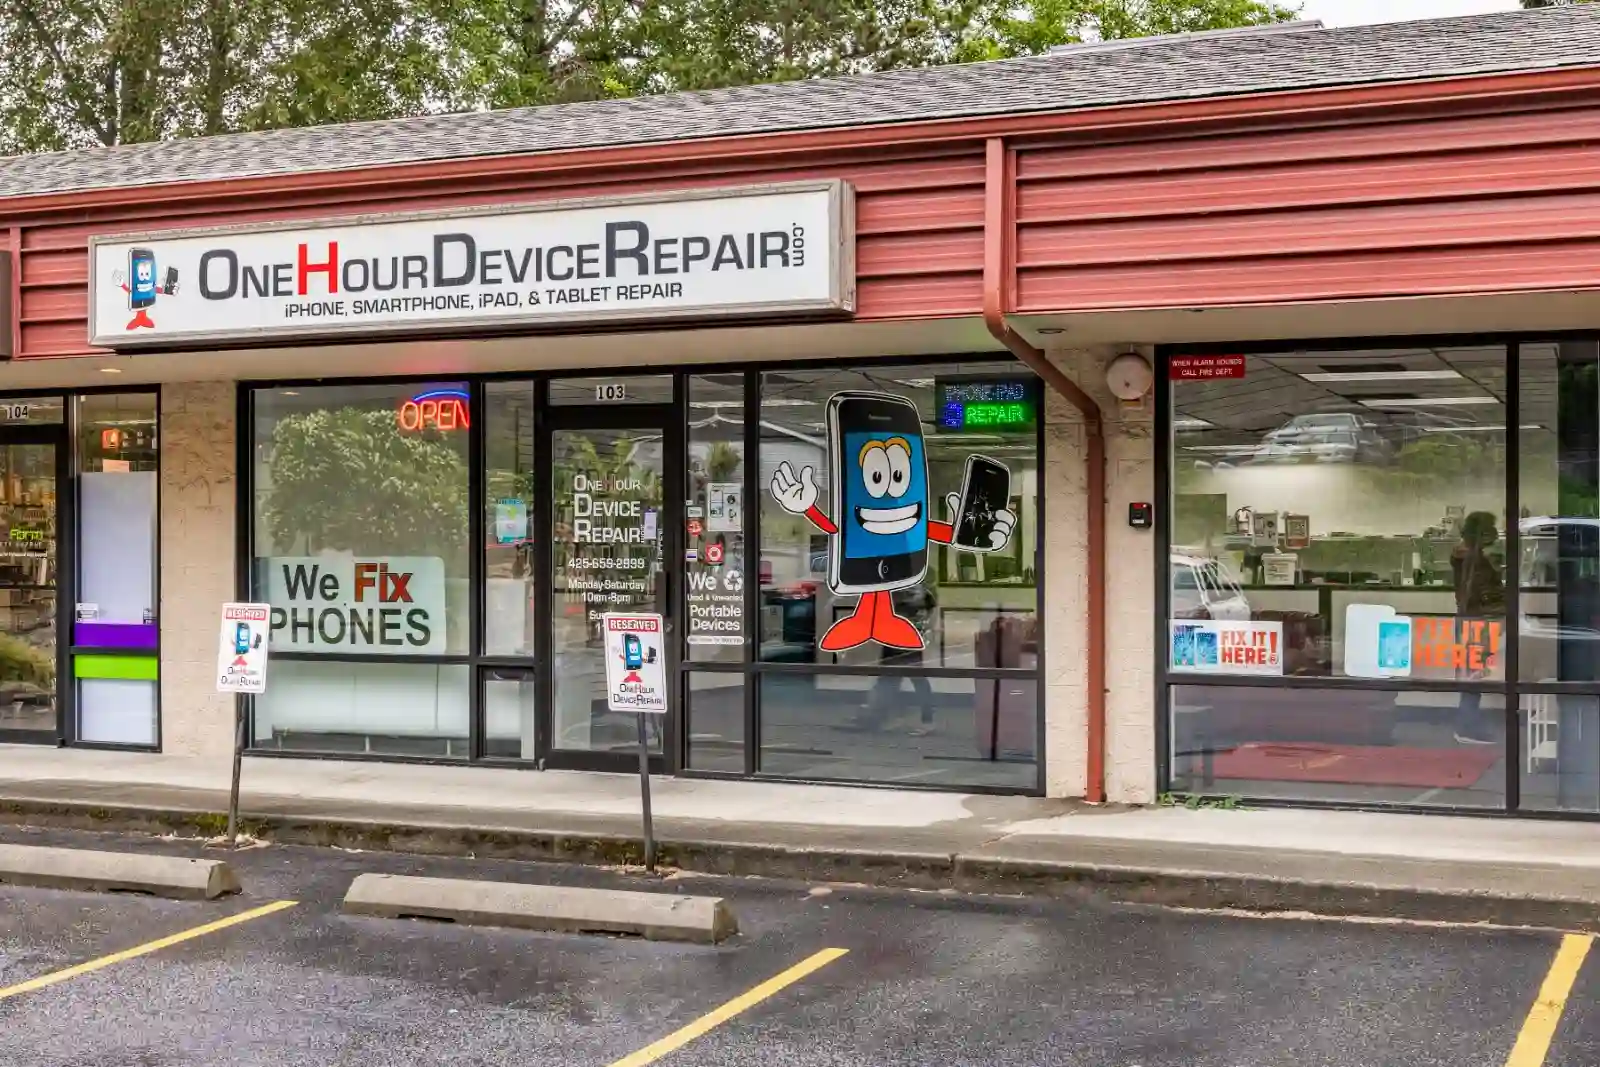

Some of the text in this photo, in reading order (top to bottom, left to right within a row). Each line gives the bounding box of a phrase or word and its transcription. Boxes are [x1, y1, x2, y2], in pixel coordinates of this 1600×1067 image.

[285, 282, 682, 318] iPHONE, SMARTPHONE, iPAD, & TABLET REPAIR
[1172, 359, 1190, 367] WHEN
[1199, 368, 1213, 376] FIRE
[598, 385, 625, 400] 103
[9, 405, 28, 419] 104
[399, 400, 470, 430] OPEN
[967, 404, 1024, 425] REPAIR
[574, 493, 641, 517] DEVICE
[574, 519, 641, 543] REPAIR
[282, 562, 414, 603] We Fix
[687, 571, 717, 591] We
[690, 604, 742, 617] Portable
[268, 607, 431, 646] PHONES
[610, 619, 657, 631] RESERVED
[692, 618, 740, 631] Devices
[1220, 630, 1247, 646] FIX
[1221, 647, 1267, 665] HERE
[1415, 643, 1485, 670] HERE
